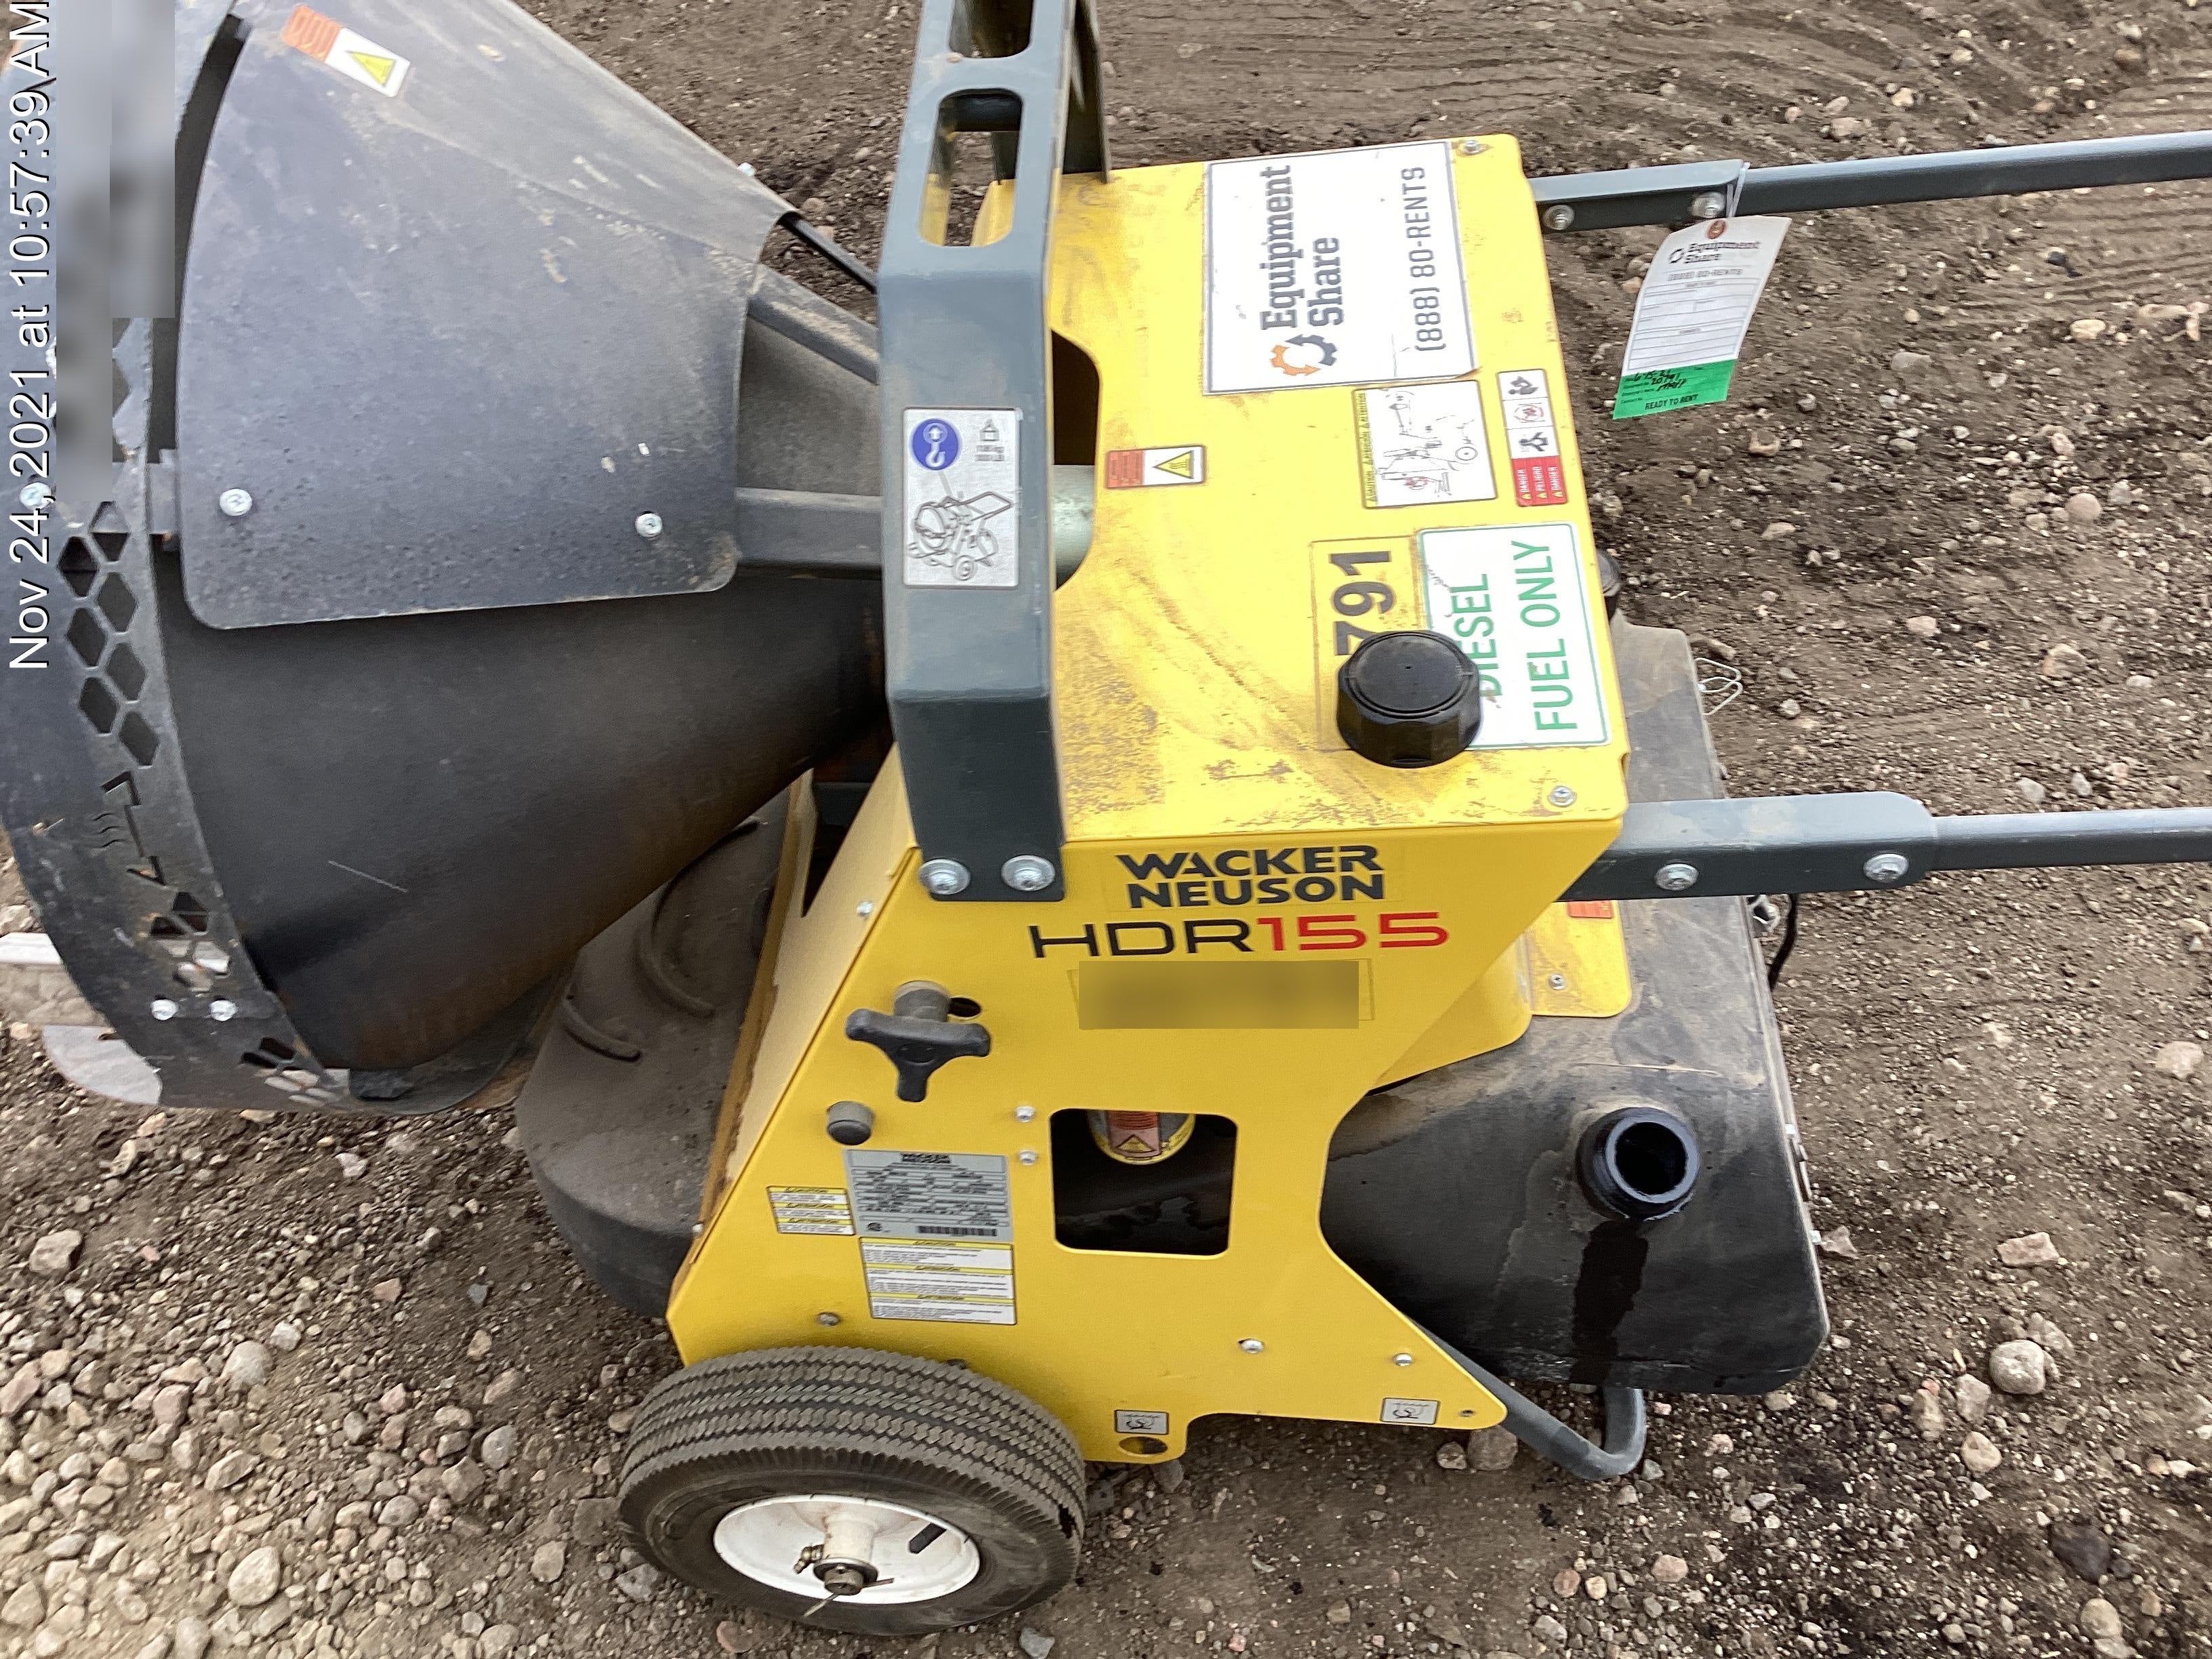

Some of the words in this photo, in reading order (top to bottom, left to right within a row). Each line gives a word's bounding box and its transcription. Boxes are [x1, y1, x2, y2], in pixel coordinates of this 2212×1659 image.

[1259, 165, 1305, 330] Equipment
[1401, 167, 1436, 278] 80-RENTS
[1307, 237, 1345, 327] Share
[1409, 287, 1447, 352] (888)
[1511, 540, 1561, 628] ONLY
[1526, 638, 1578, 730] FUEL
[1116, 845, 1385, 880] WACKER
[1127, 874, 1384, 909] NEUSON
[1027, 912, 1449, 958] HDR155
